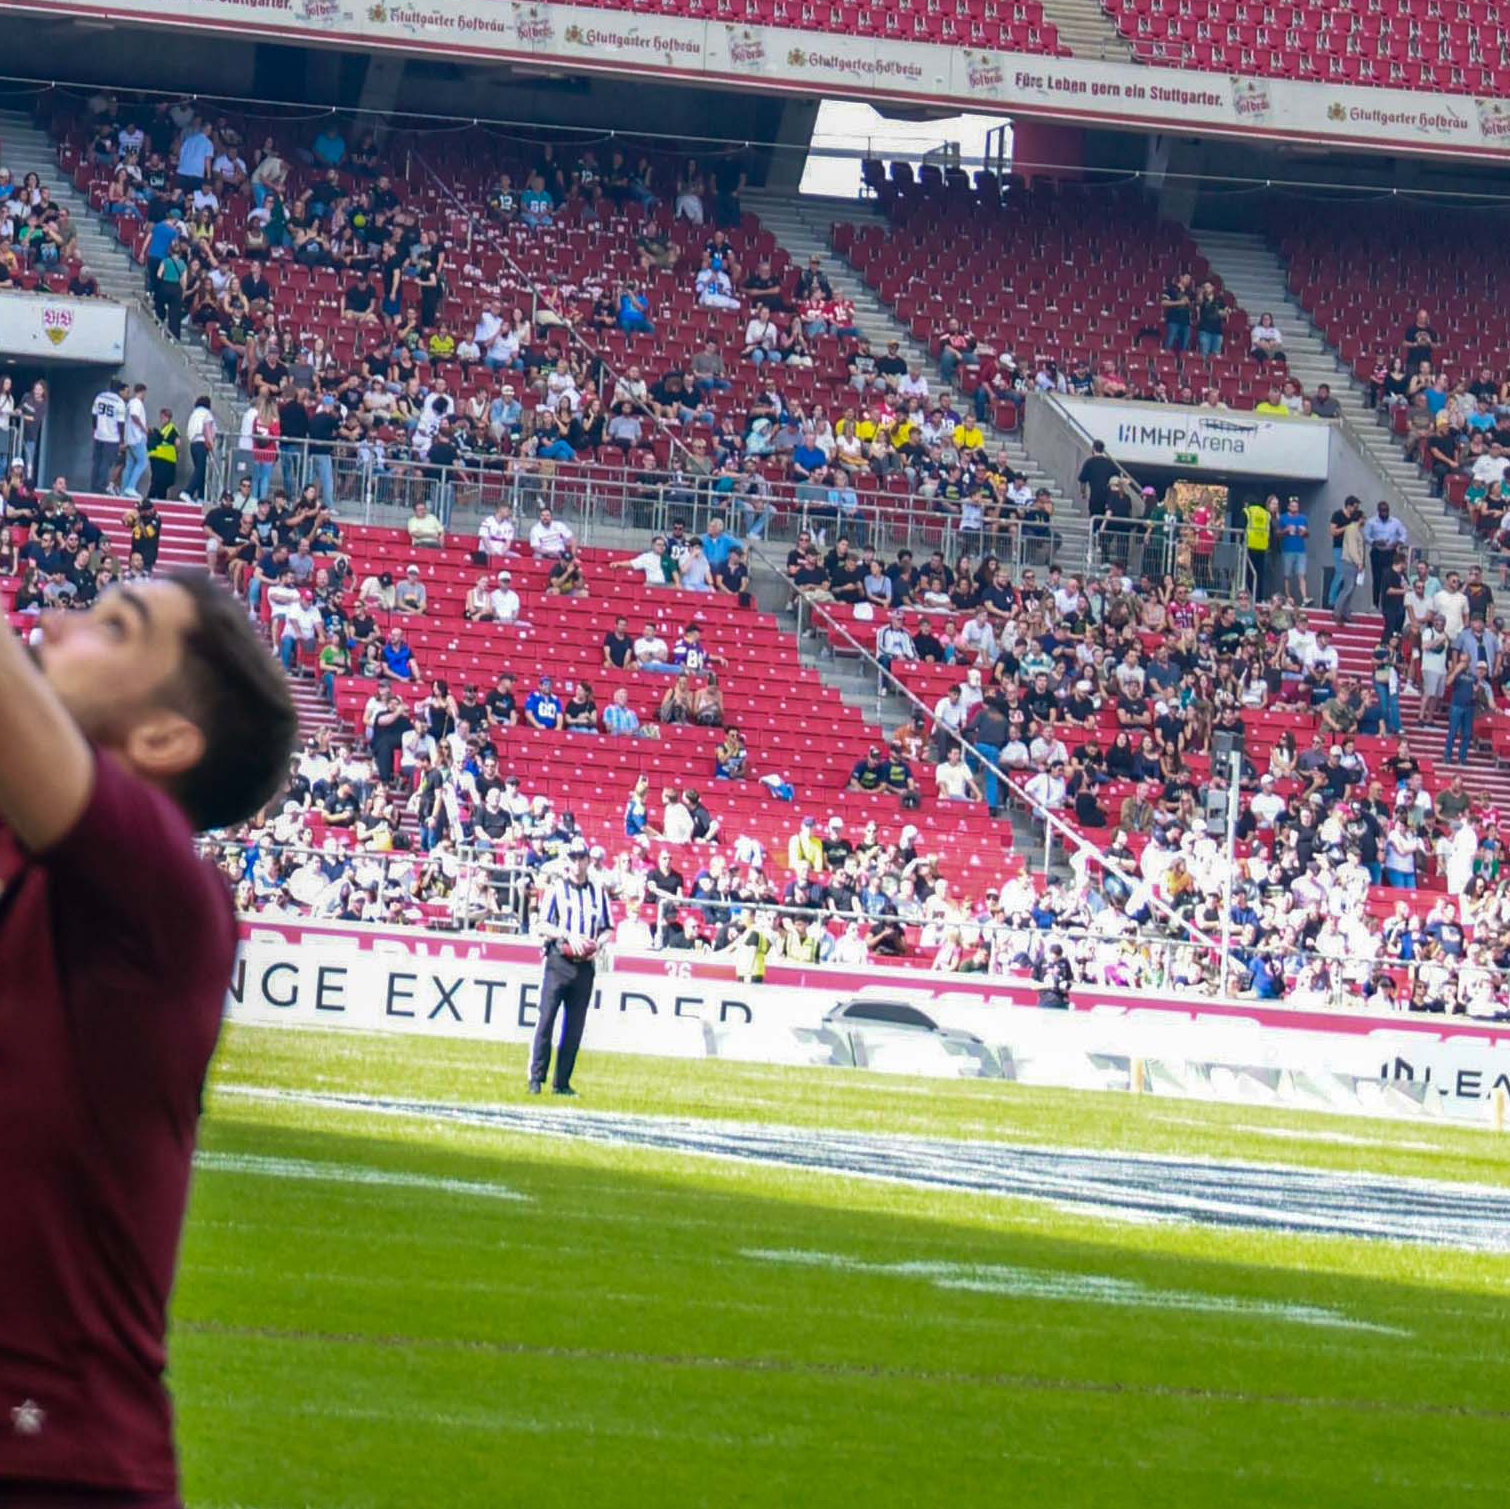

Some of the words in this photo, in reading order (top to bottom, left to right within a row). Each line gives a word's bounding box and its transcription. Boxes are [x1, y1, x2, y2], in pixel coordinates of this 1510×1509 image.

[1015, 71, 1043, 89] Fürs
[1047, 75, 1086, 94] Leben
[1092, 80, 1120, 100] gern
[1125, 82, 1146, 100] ein
[1150, 85, 1224, 108] Stuttgarter.
[500, 195, 512, 211] 12
[1141, 426, 1186, 447] MHP
[1188, 432, 1244, 453] Arena
